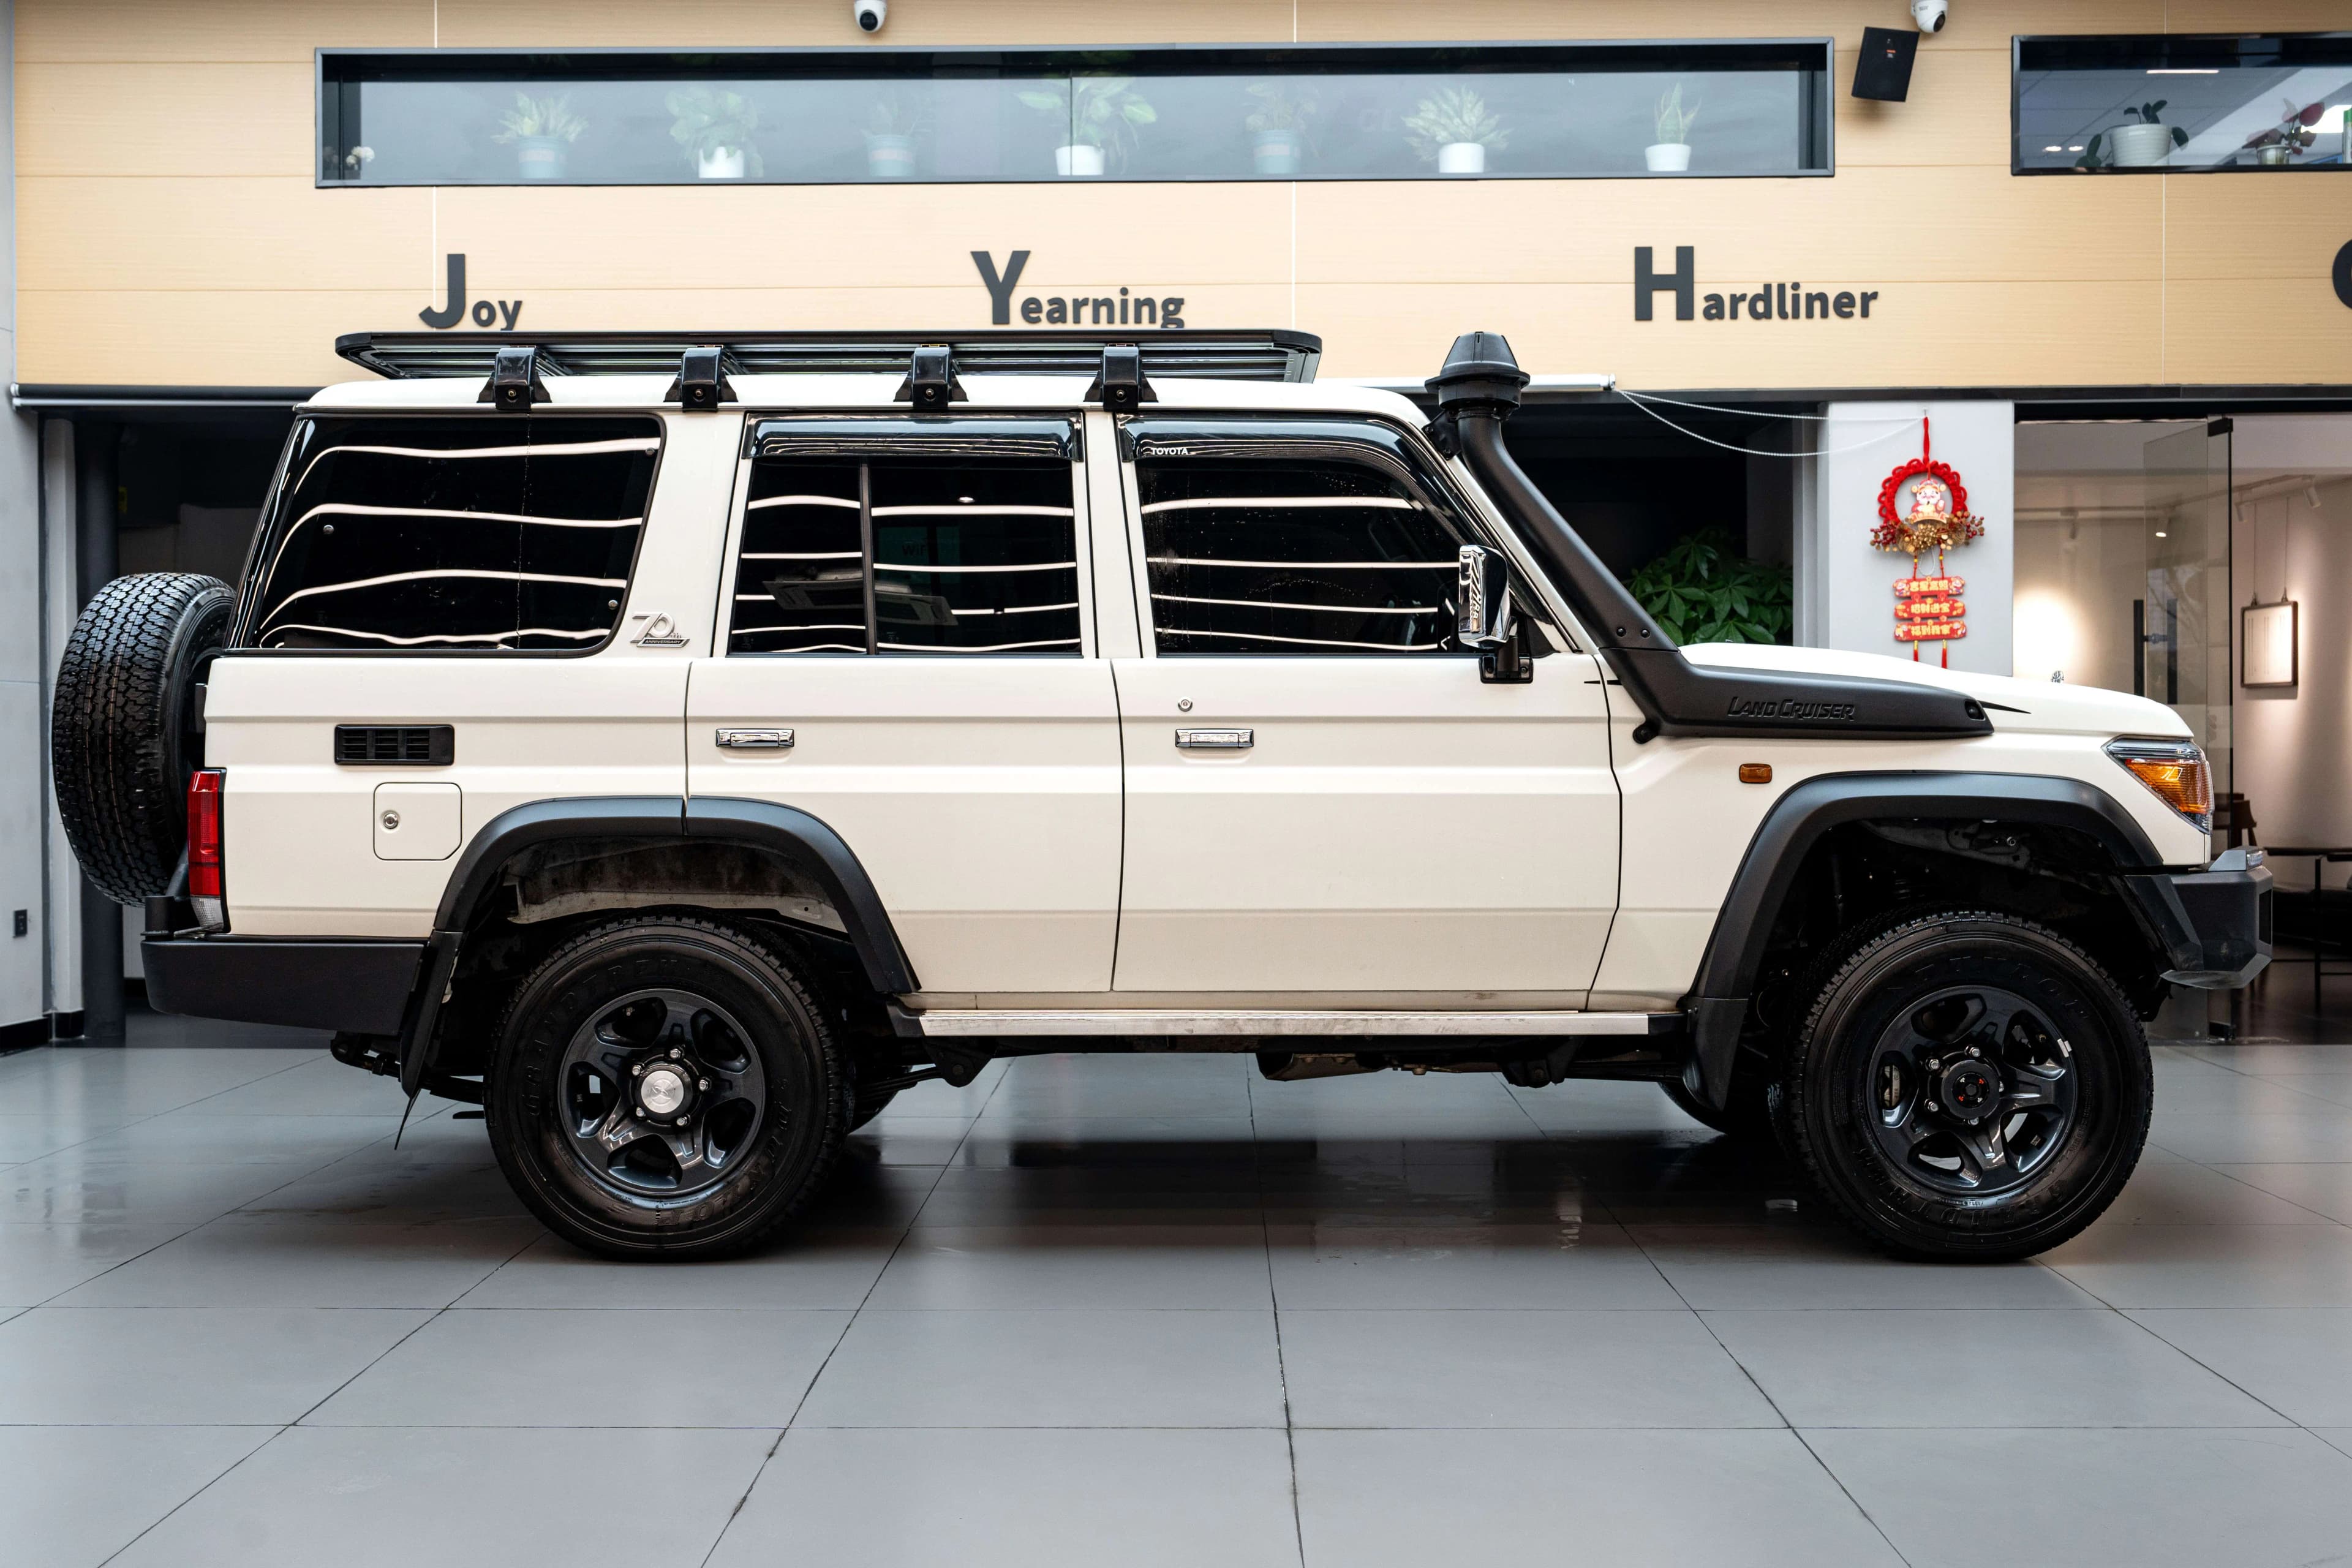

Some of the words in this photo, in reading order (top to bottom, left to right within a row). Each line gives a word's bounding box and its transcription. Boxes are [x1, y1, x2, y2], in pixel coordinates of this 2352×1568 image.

[418, 253, 523, 331] Joy
[970, 250, 1185, 329] Yearning
[1634, 246, 1879, 321] Hardliner
[1727, 696, 1777, 717] LAND
[1779, 698, 1855, 721] CRUISER
